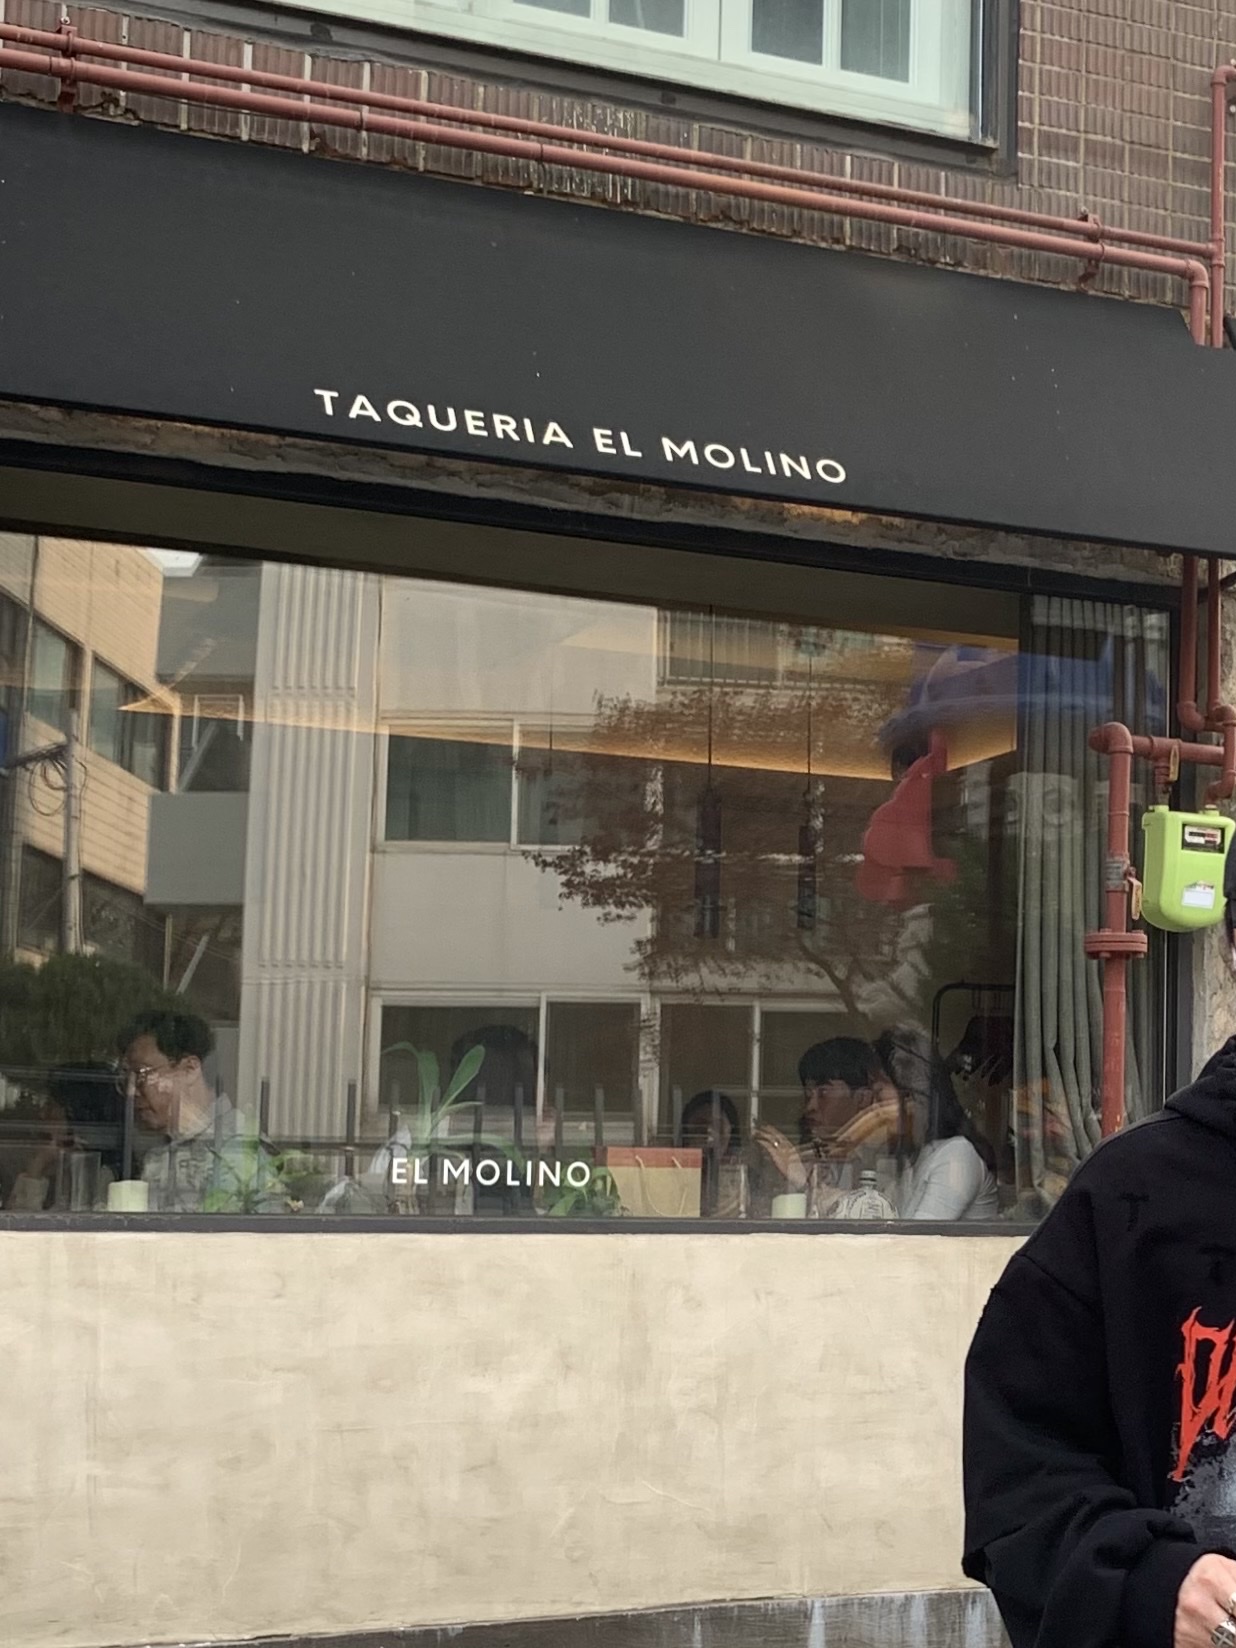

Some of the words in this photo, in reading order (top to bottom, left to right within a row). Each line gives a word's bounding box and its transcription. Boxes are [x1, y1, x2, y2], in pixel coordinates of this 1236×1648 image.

[313, 388, 574, 449] TAQUERIA
[593, 427, 643, 458] EL
[660, 435, 847, 485] MOLINO
[391, 1157, 428, 1185] EL
[442, 1158, 591, 1188] MOLINO
